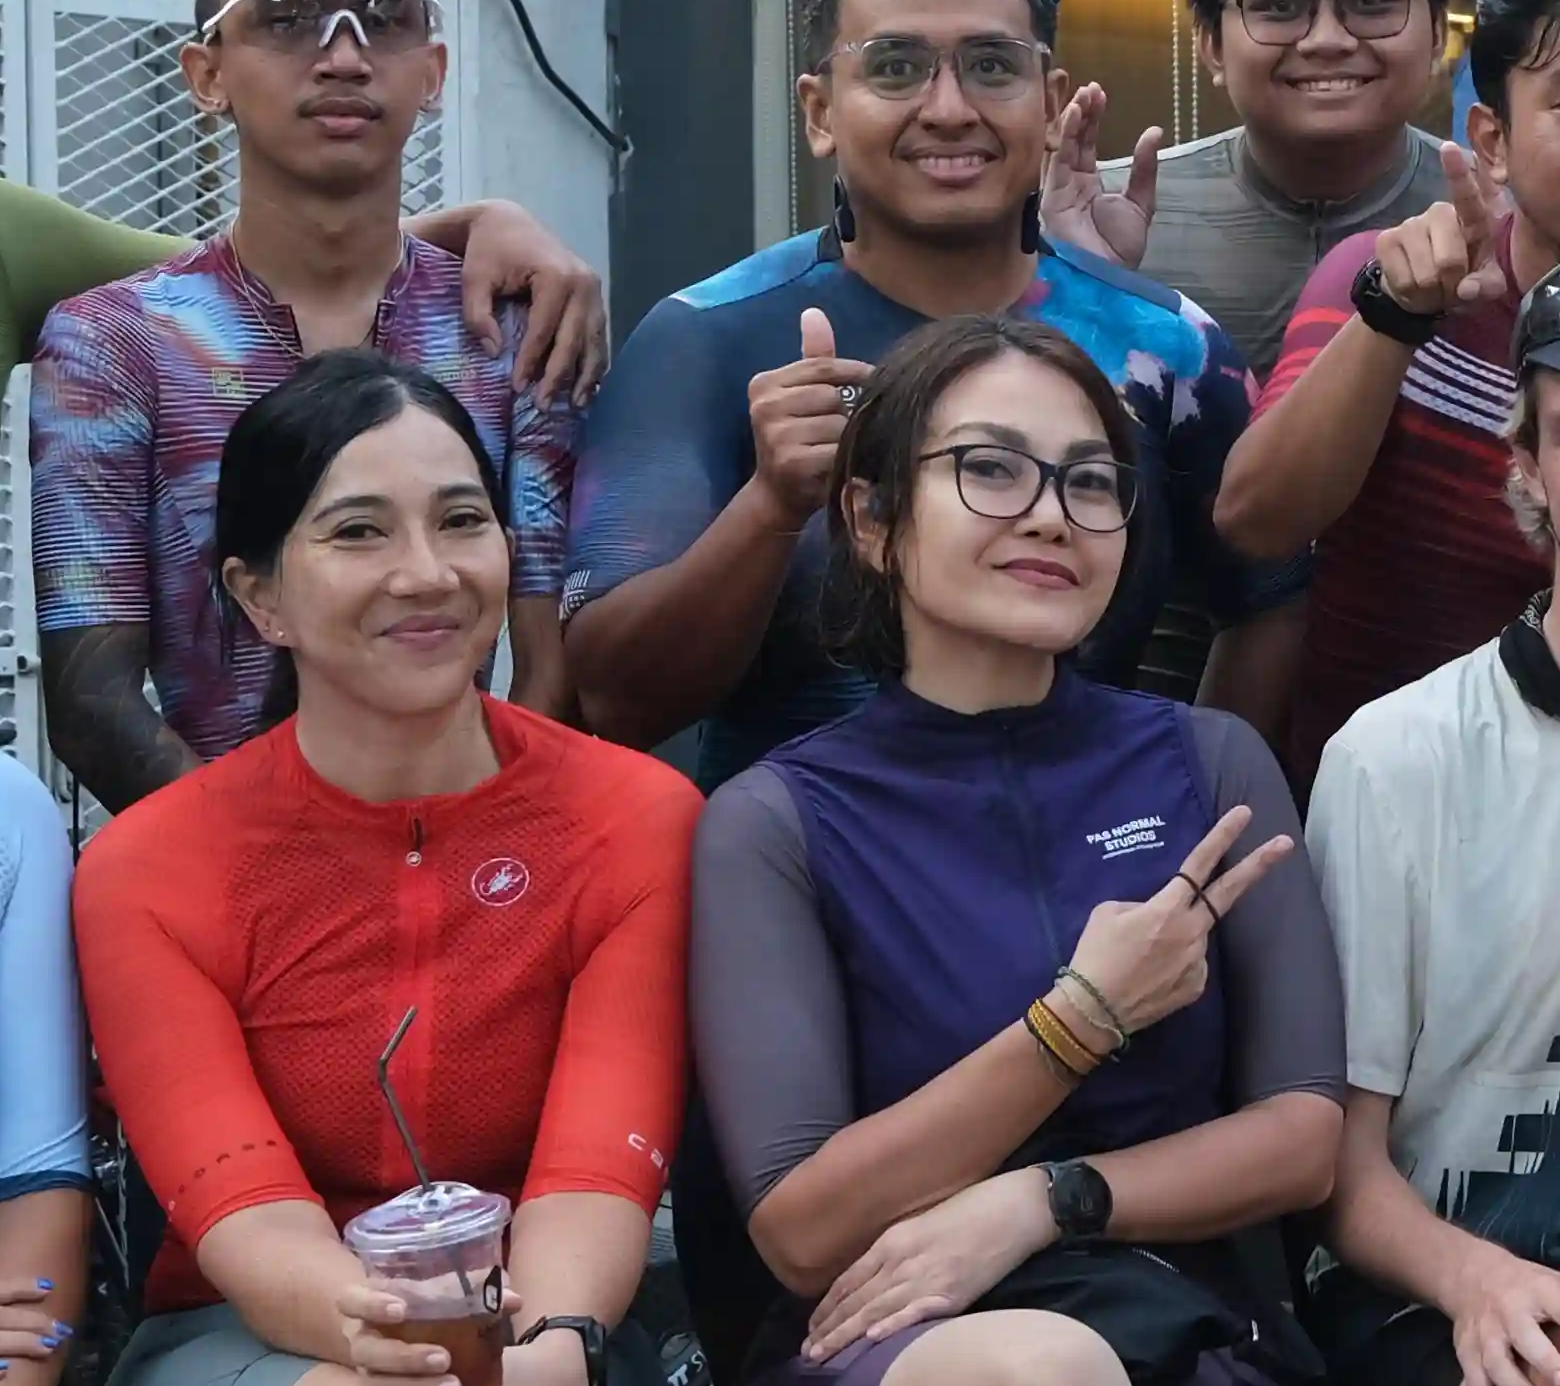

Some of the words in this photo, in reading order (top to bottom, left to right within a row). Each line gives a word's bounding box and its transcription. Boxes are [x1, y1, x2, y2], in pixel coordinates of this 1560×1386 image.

[1086, 830, 1111, 844] PAS
[1111, 814, 1166, 837] NORMAL
[1104, 830, 1156, 851] STUDIOS
